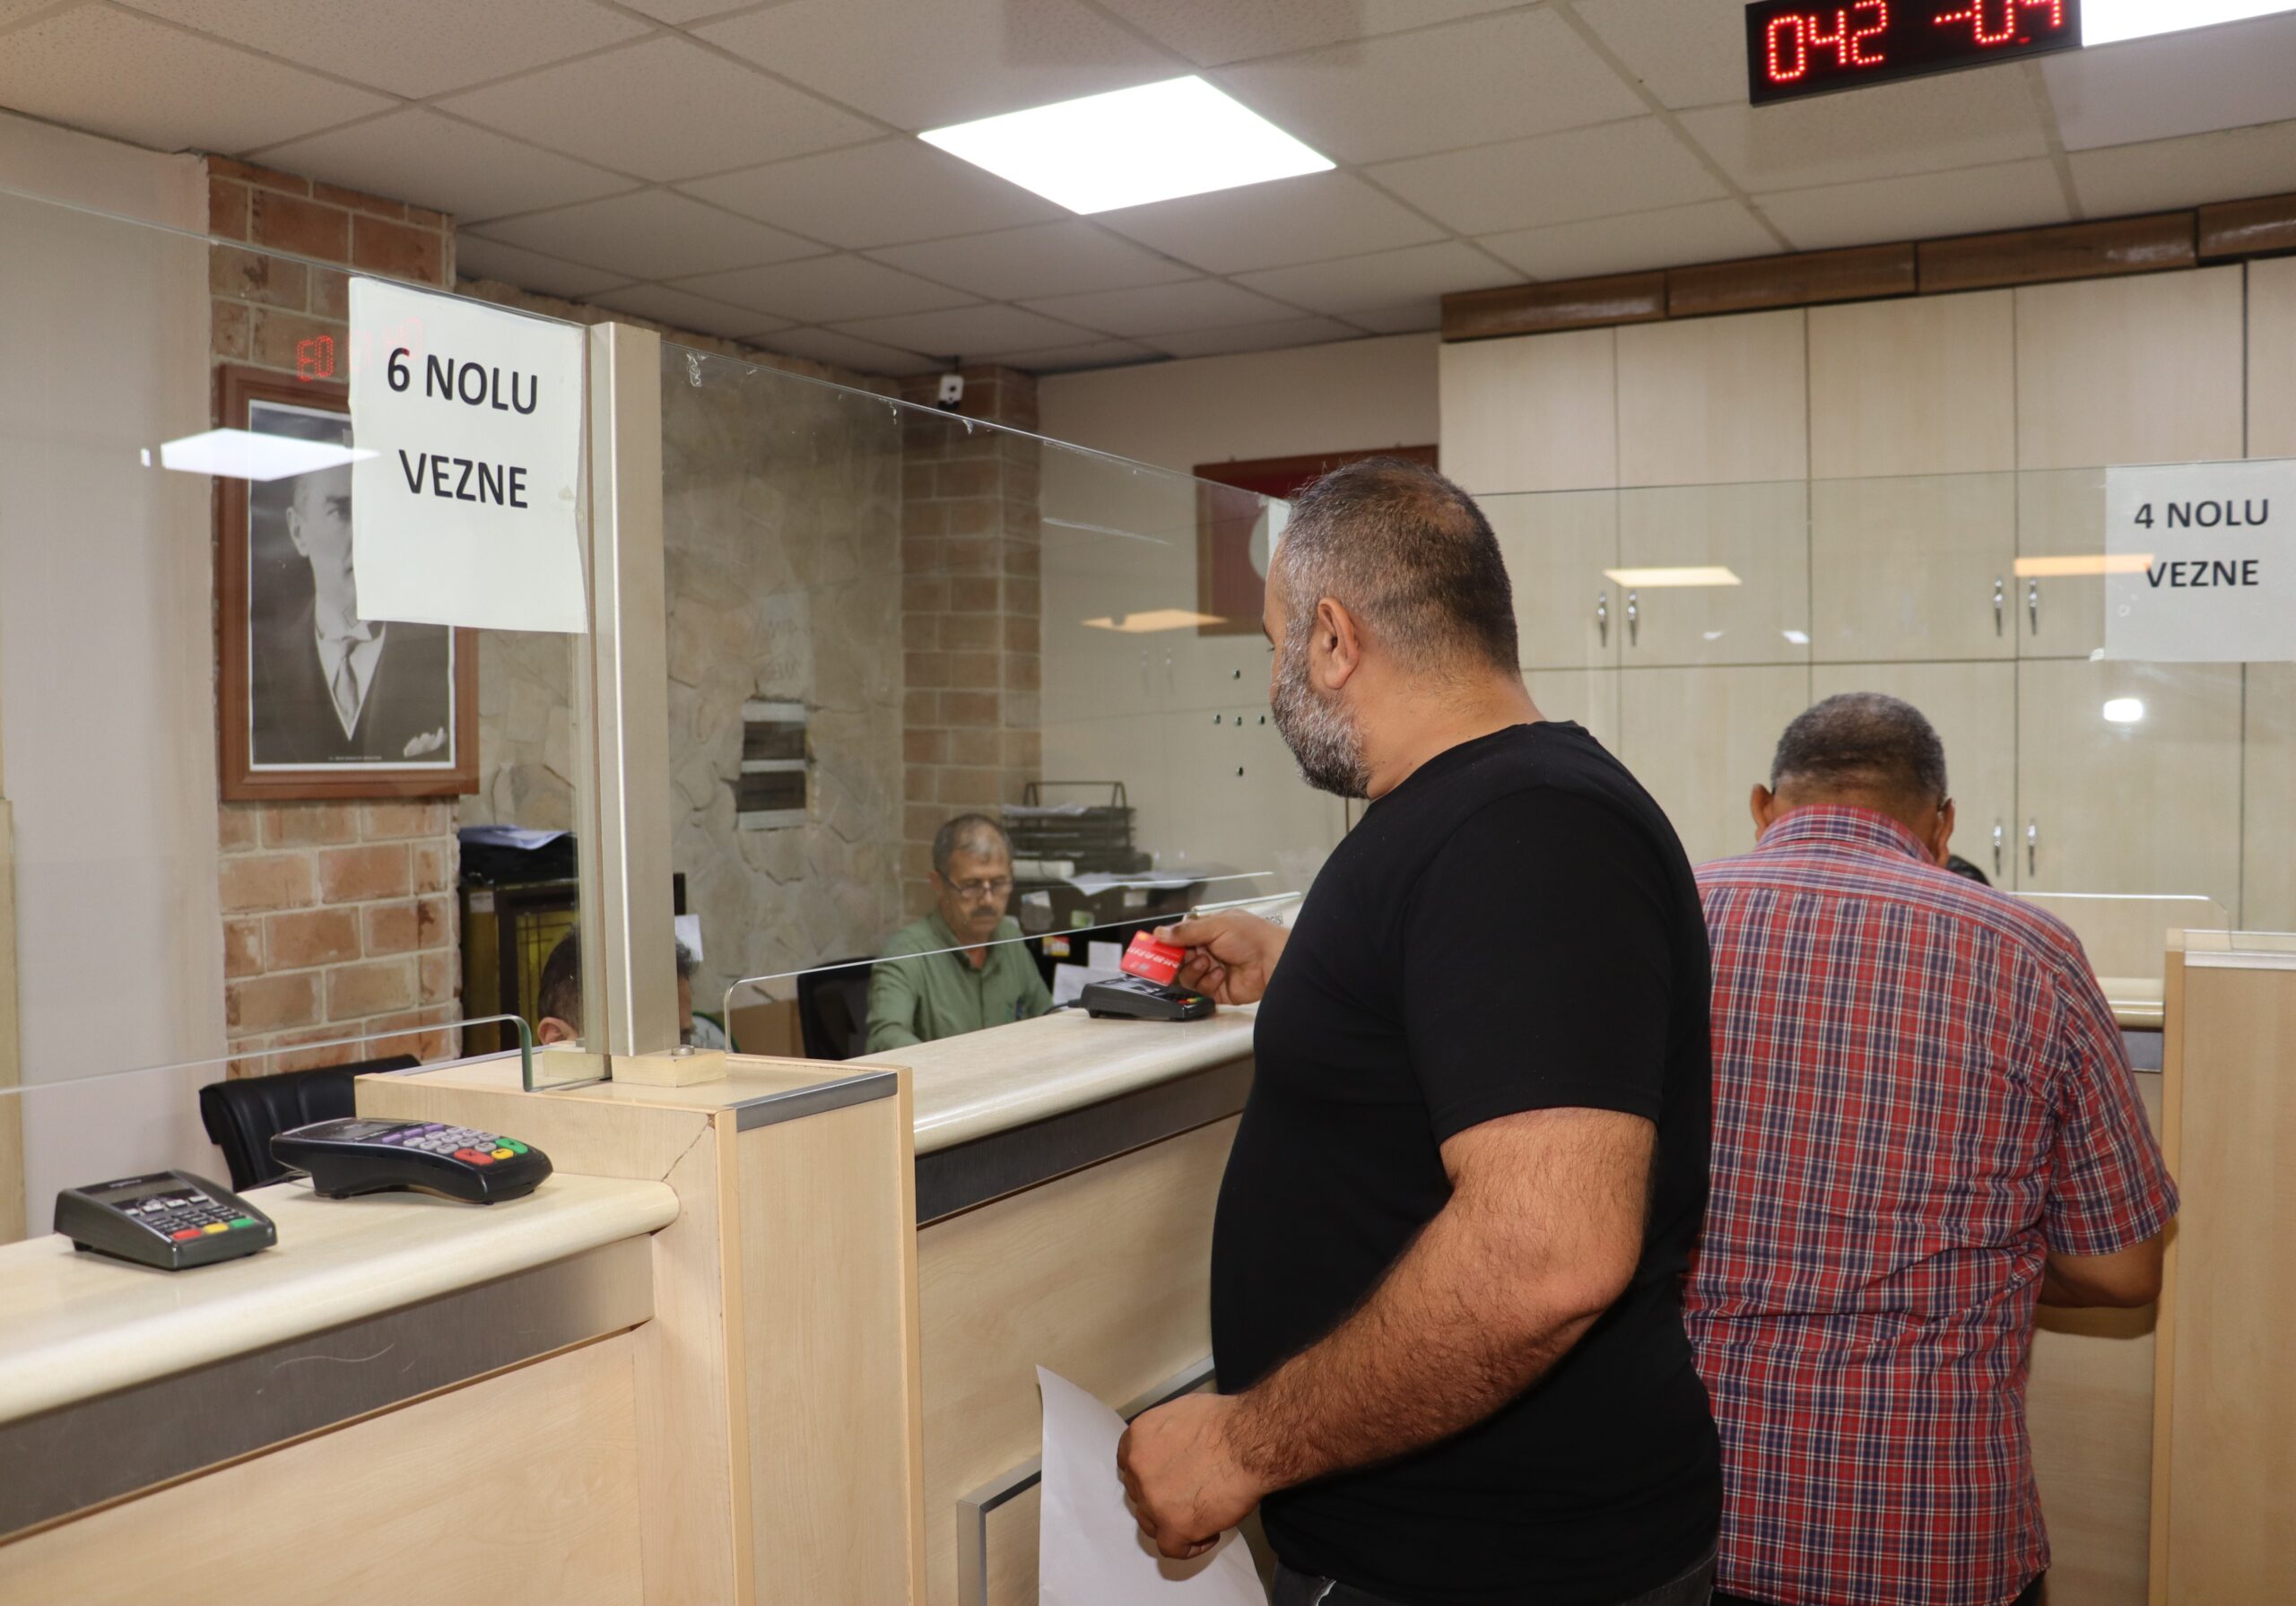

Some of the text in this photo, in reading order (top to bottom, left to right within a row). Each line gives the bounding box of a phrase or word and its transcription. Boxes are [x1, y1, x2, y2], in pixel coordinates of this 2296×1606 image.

[1767, 0, 1888, 81] 042
[387, 347, 539, 415] 6 NOLU
[398, 449, 529, 509] VEZNE
[2134, 499, 2269, 529] 4 NOLU
[2144, 560, 2259, 588] VEZNE
